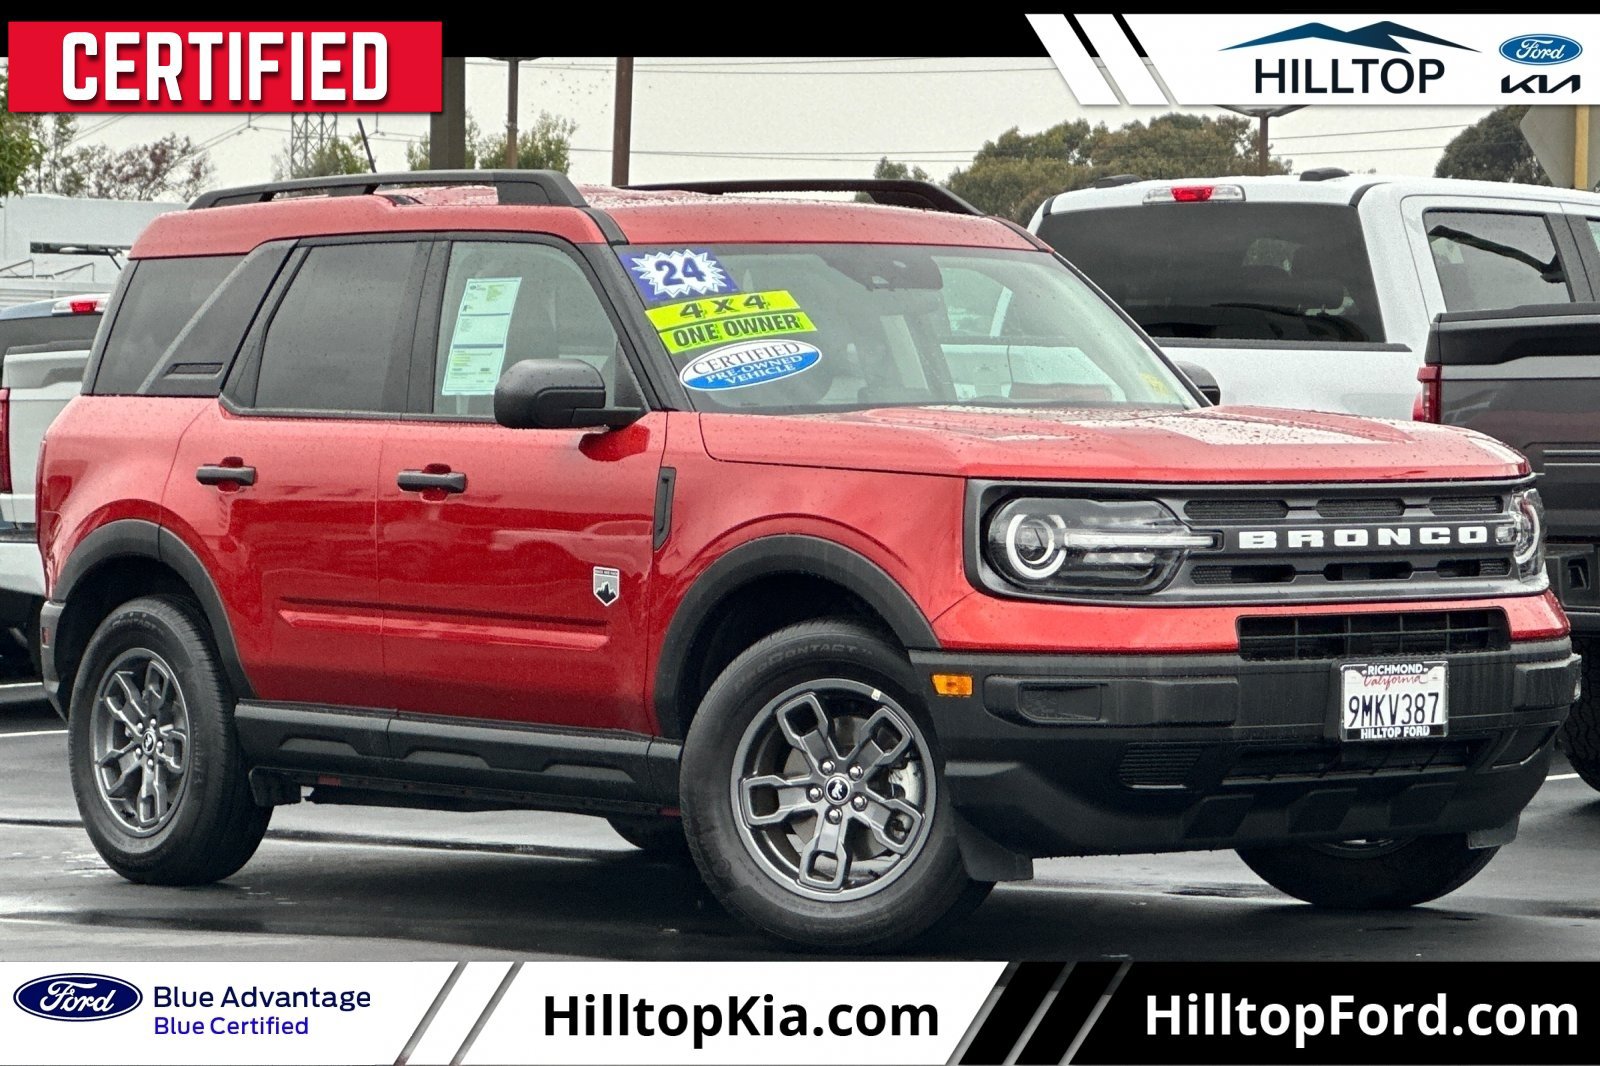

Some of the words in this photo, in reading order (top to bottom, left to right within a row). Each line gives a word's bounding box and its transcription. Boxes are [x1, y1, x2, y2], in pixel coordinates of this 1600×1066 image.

[655, 257, 707, 287] 24
[673, 322, 720, 348] ONE
[723, 313, 801, 337] OWNER
[692, 342, 801, 375] CERTIFIED
[706, 355, 804, 383] PRE-OWNED
[724, 363, 797, 386] VEHICLE
[1239, 526, 1488, 549] BRONCO
[1368, 663, 1423, 676] RICHMOND
[1363, 675, 1428, 691] California
[1348, 692, 1439, 728] 9MKV387
[1360, 726, 1402, 740] HILLTOP
[1403, 725, 1430, 737] FORD
